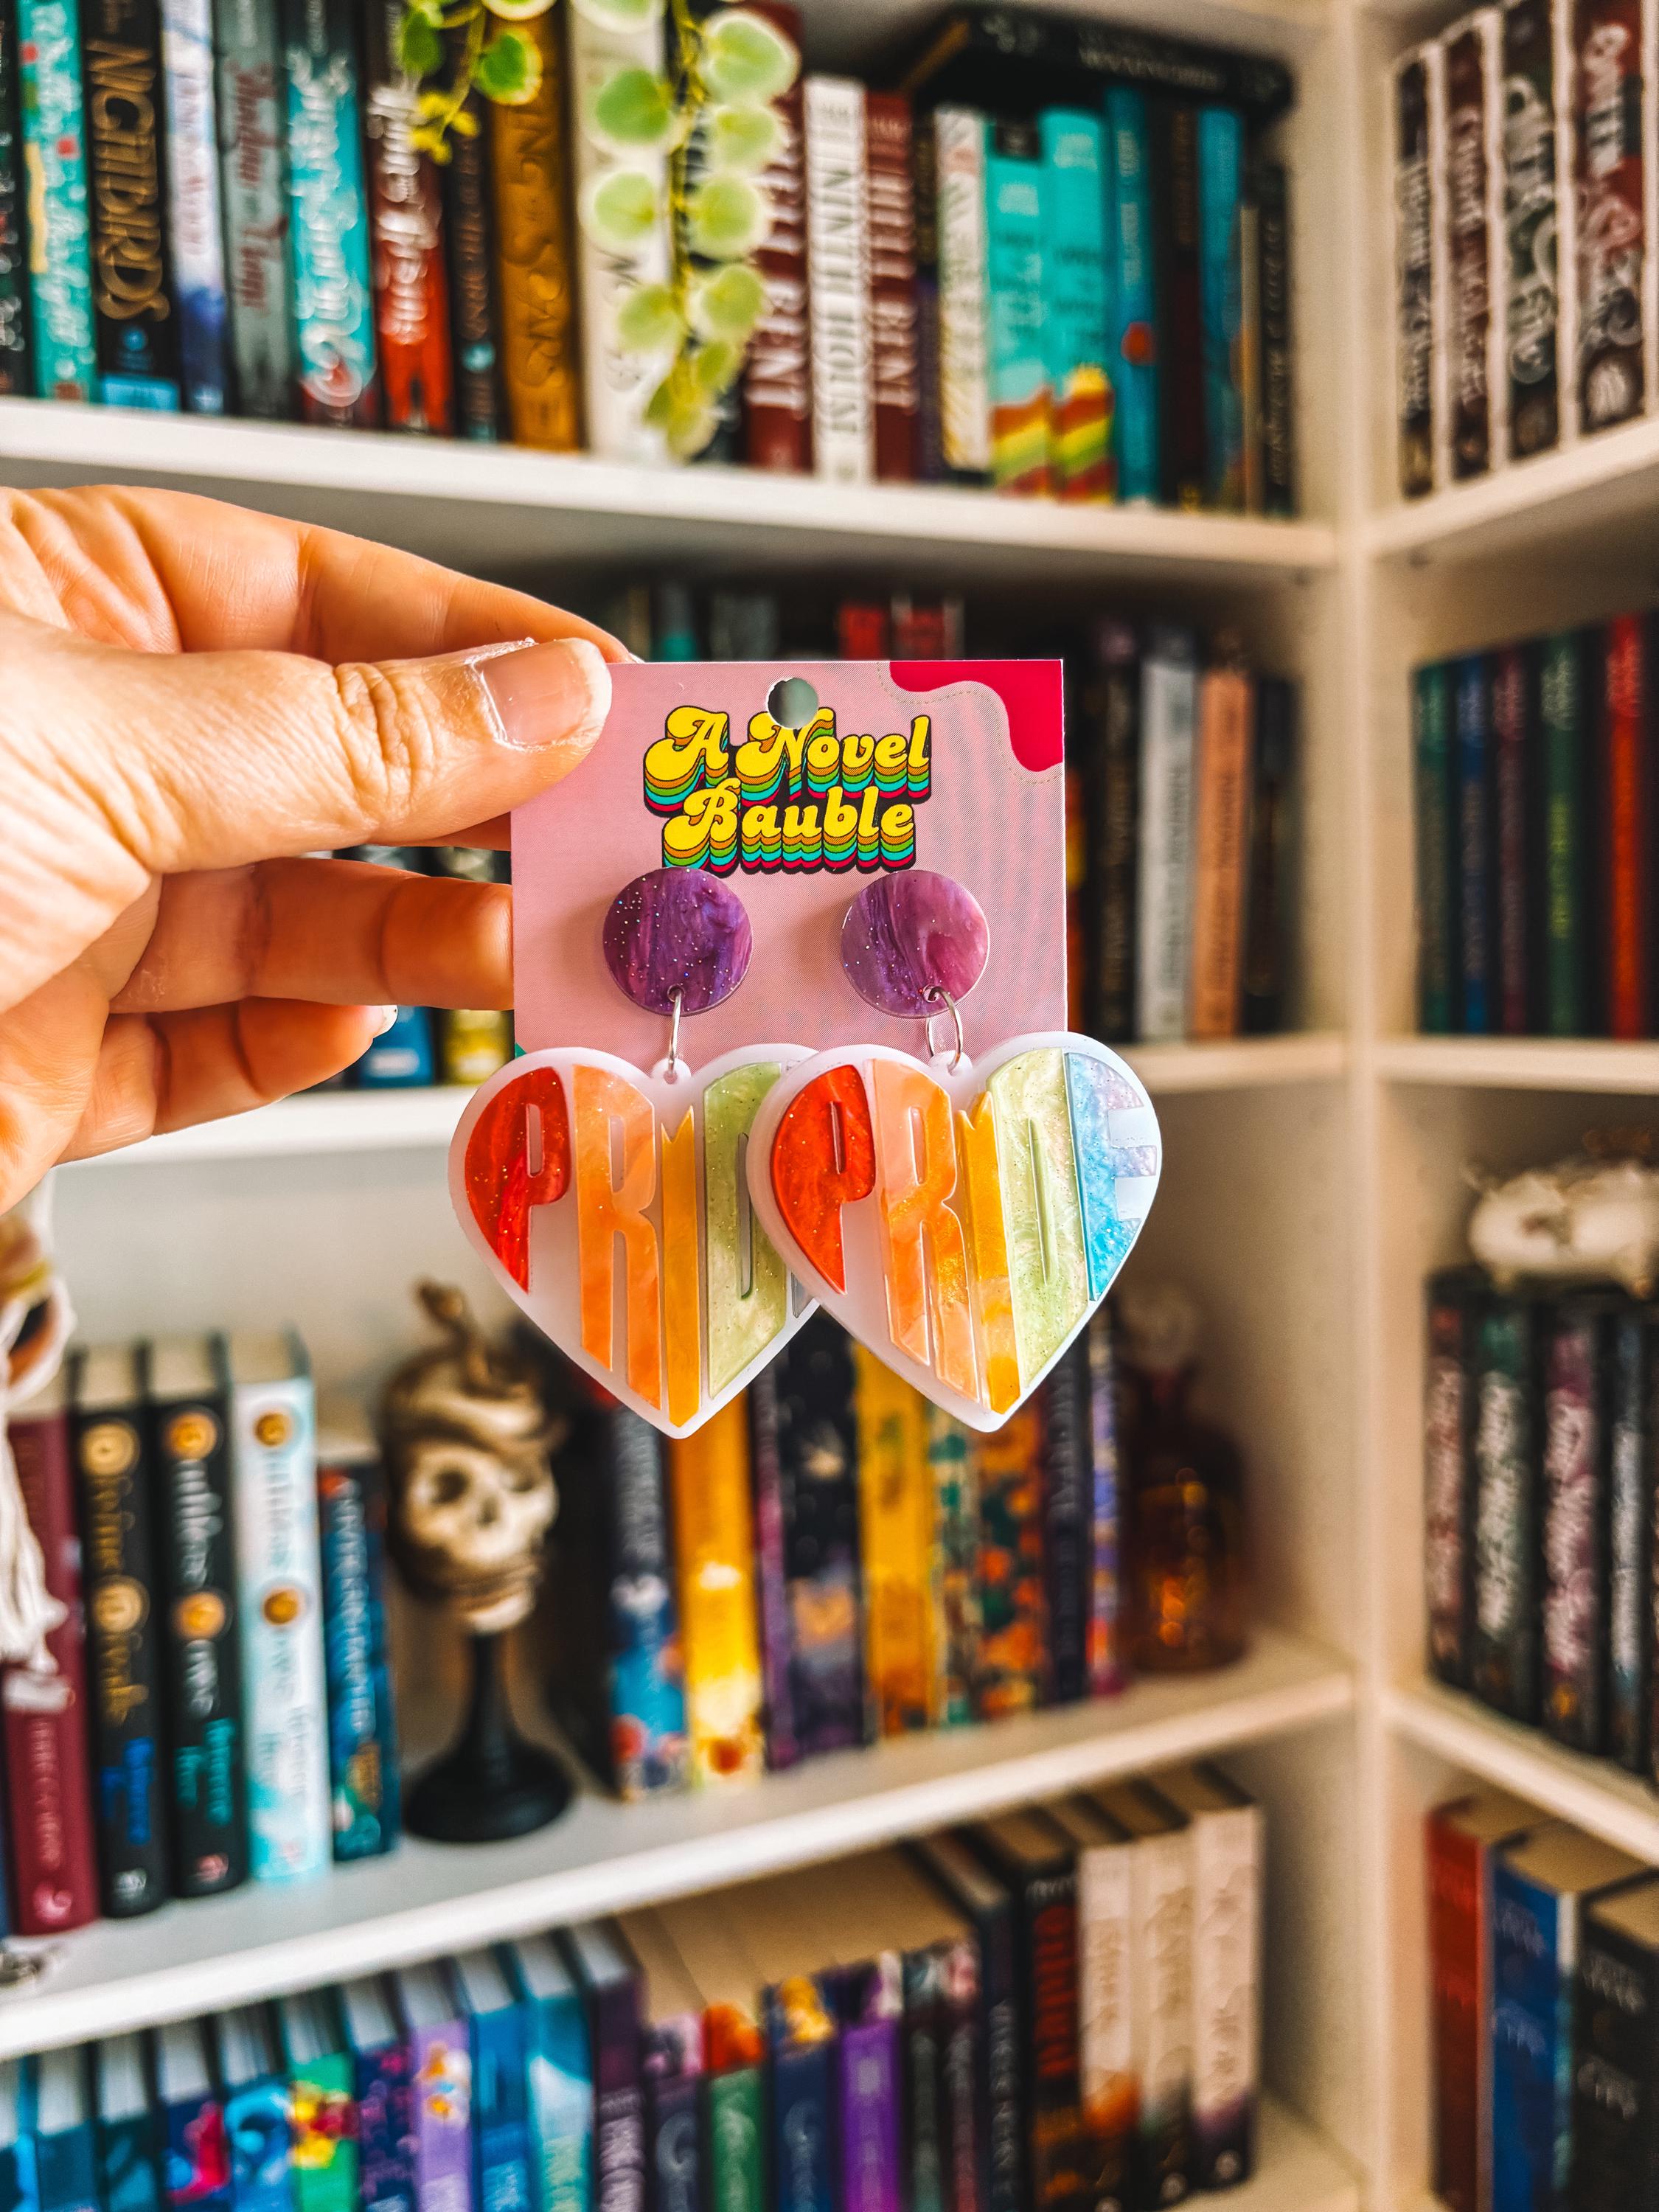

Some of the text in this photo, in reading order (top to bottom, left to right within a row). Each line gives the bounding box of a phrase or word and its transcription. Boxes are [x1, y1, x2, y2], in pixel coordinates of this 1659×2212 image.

[643, 705, 932, 811] A Novel
[662, 777, 915, 869] Bauble
[465, 1062, 818, 1427] PRID
[771, 1048, 1157, 1414] PRIDE
